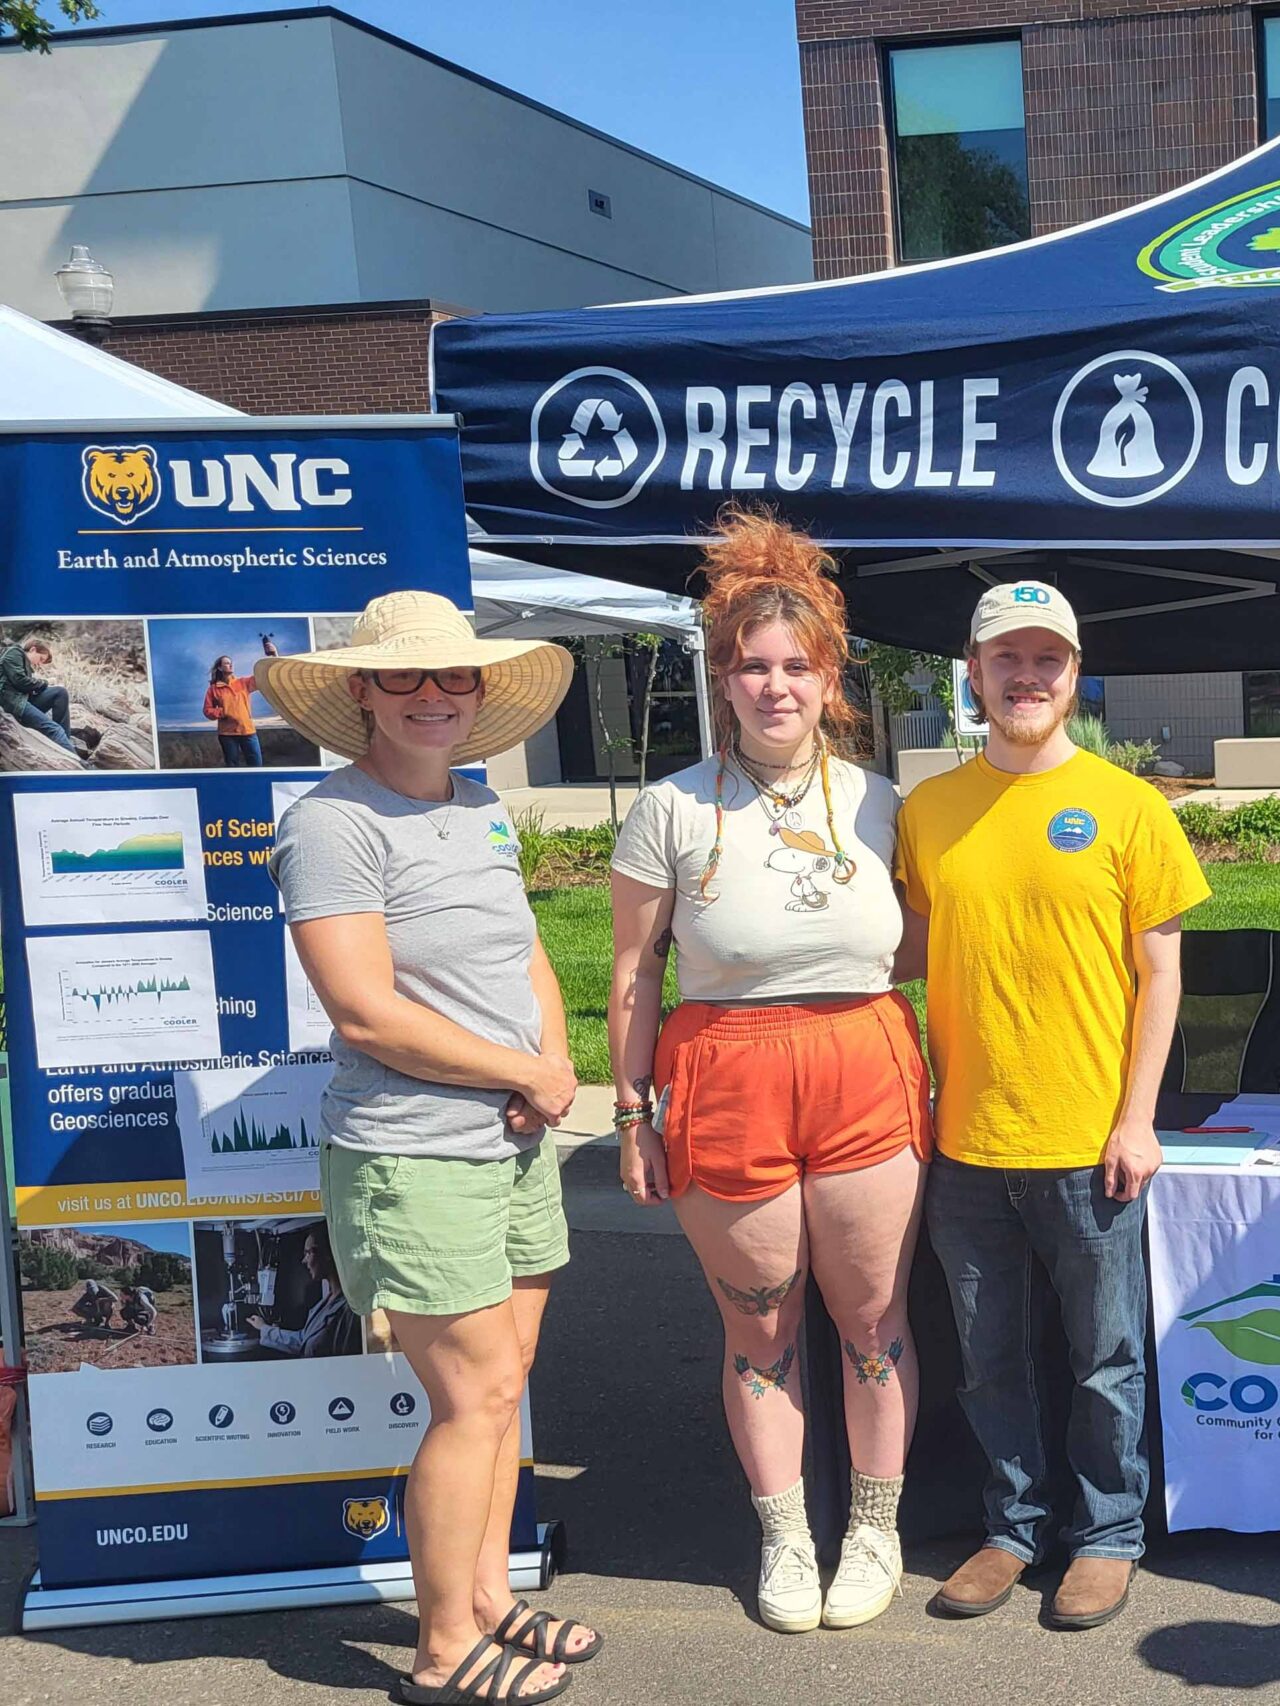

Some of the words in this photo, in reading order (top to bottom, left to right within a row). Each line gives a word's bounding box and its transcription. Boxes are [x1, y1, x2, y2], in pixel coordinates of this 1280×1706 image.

[680, 377, 1000, 492] RECYCLE
[169, 453, 353, 512] UNC
[57, 549, 118, 570] Earth
[124, 548, 160, 568] and
[165, 547, 297, 573] Atmospheric
[302, 546, 388, 567] Sciences
[1010, 586, 1051, 605] 150
[205, 819, 223, 838] of
[207, 902, 274, 922] Science
[48, 1084, 104, 1103] offers
[50, 1110, 169, 1131] Geosciences
[58, 1197, 89, 1213] visit
[95, 1196, 112, 1210] us
[117, 1194, 132, 1209] at
[325, 1427, 342, 1435] FIELD
[343, 1425, 360, 1433] WORK
[388, 1421, 420, 1430] DISCOVERY
[1196, 1414, 1272, 1430] Community
[144, 1437, 178, 1446] EDUCATION
[195, 1434, 225, 1443] SCIENTIFIC
[226, 1433, 250, 1441] WRITING
[267, 1429, 302, 1439] INNOVATION
[1254, 1429, 1274, 1440] for
[86, 1441, 117, 1450] RESEARCH
[96, 1522, 189, 1546] UNCO.EDU
